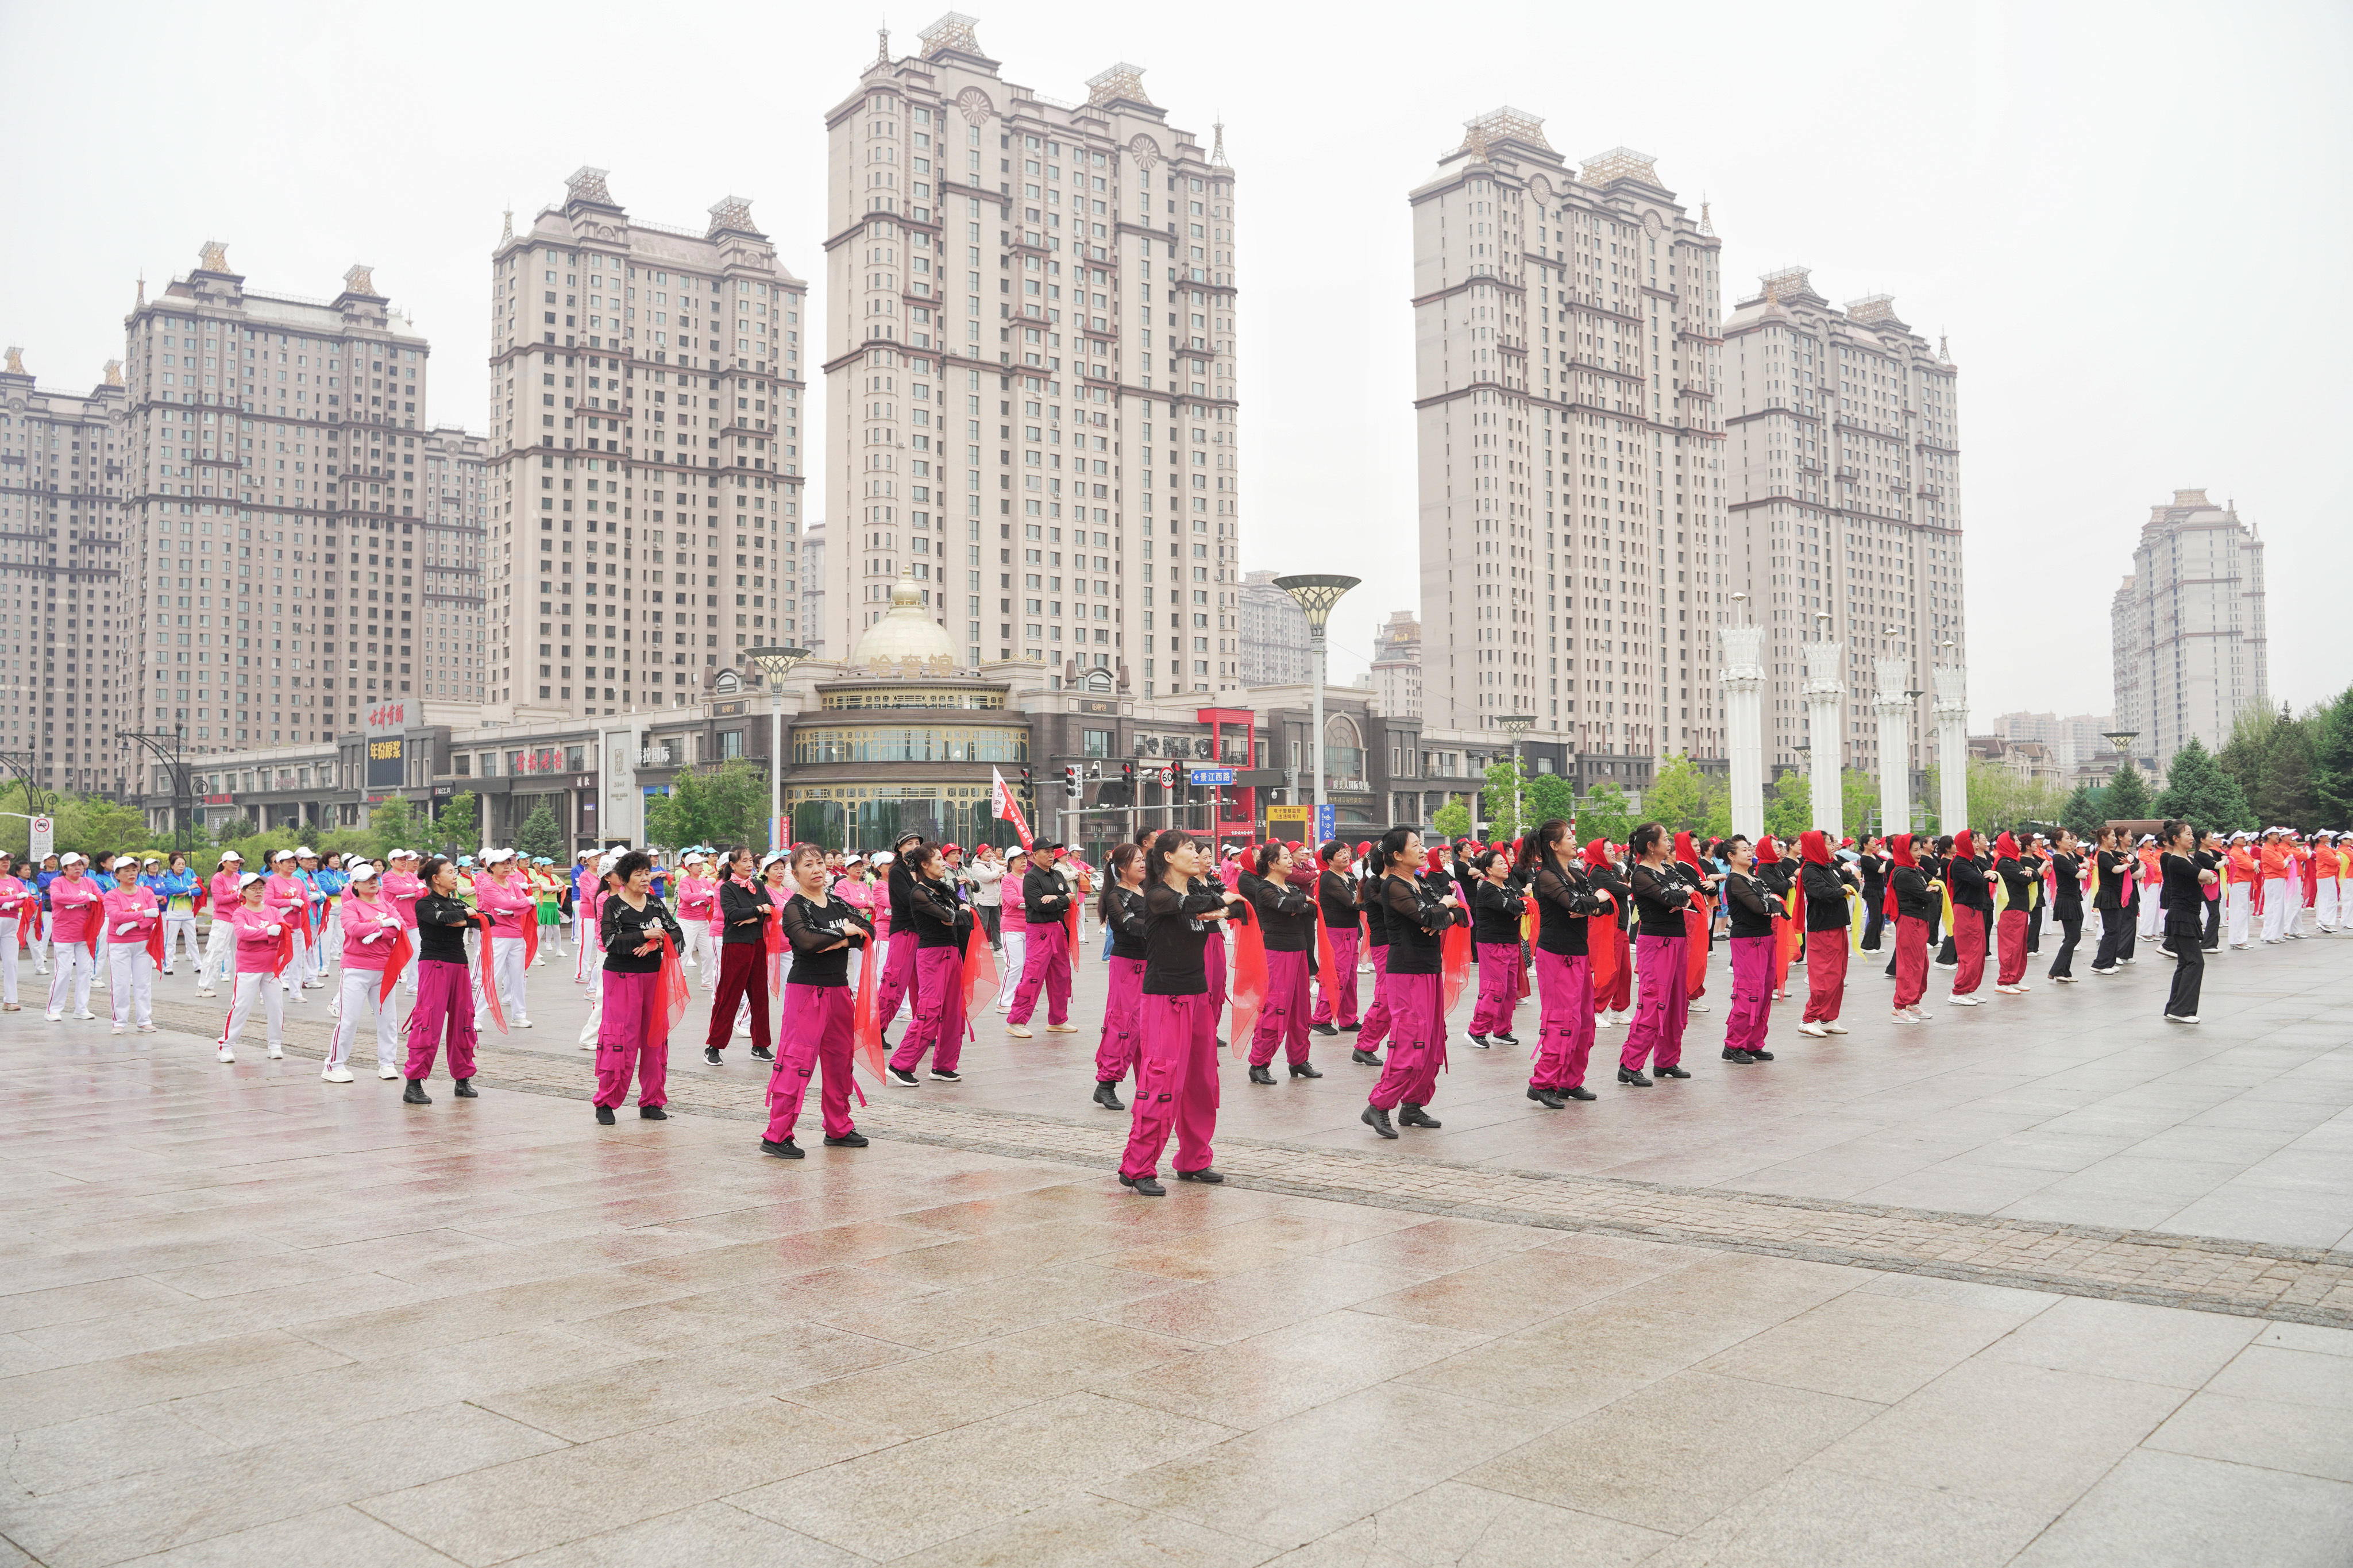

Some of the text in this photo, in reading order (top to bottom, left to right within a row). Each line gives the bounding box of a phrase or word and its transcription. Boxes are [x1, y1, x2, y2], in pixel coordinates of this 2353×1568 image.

[370, 740, 401, 760] 年份原浆
[516, 750, 563, 771] 富裕老窖
[1162, 773, 1172, 782] 60
[1200, 773, 1230, 782] 景江西路
[1333, 779, 1369, 790] 虞美人国际集团
[1323, 814, 1333, 838] 哈洽会
[288, 887, 296, 896] 中
[130, 902, 141, 912] 中
